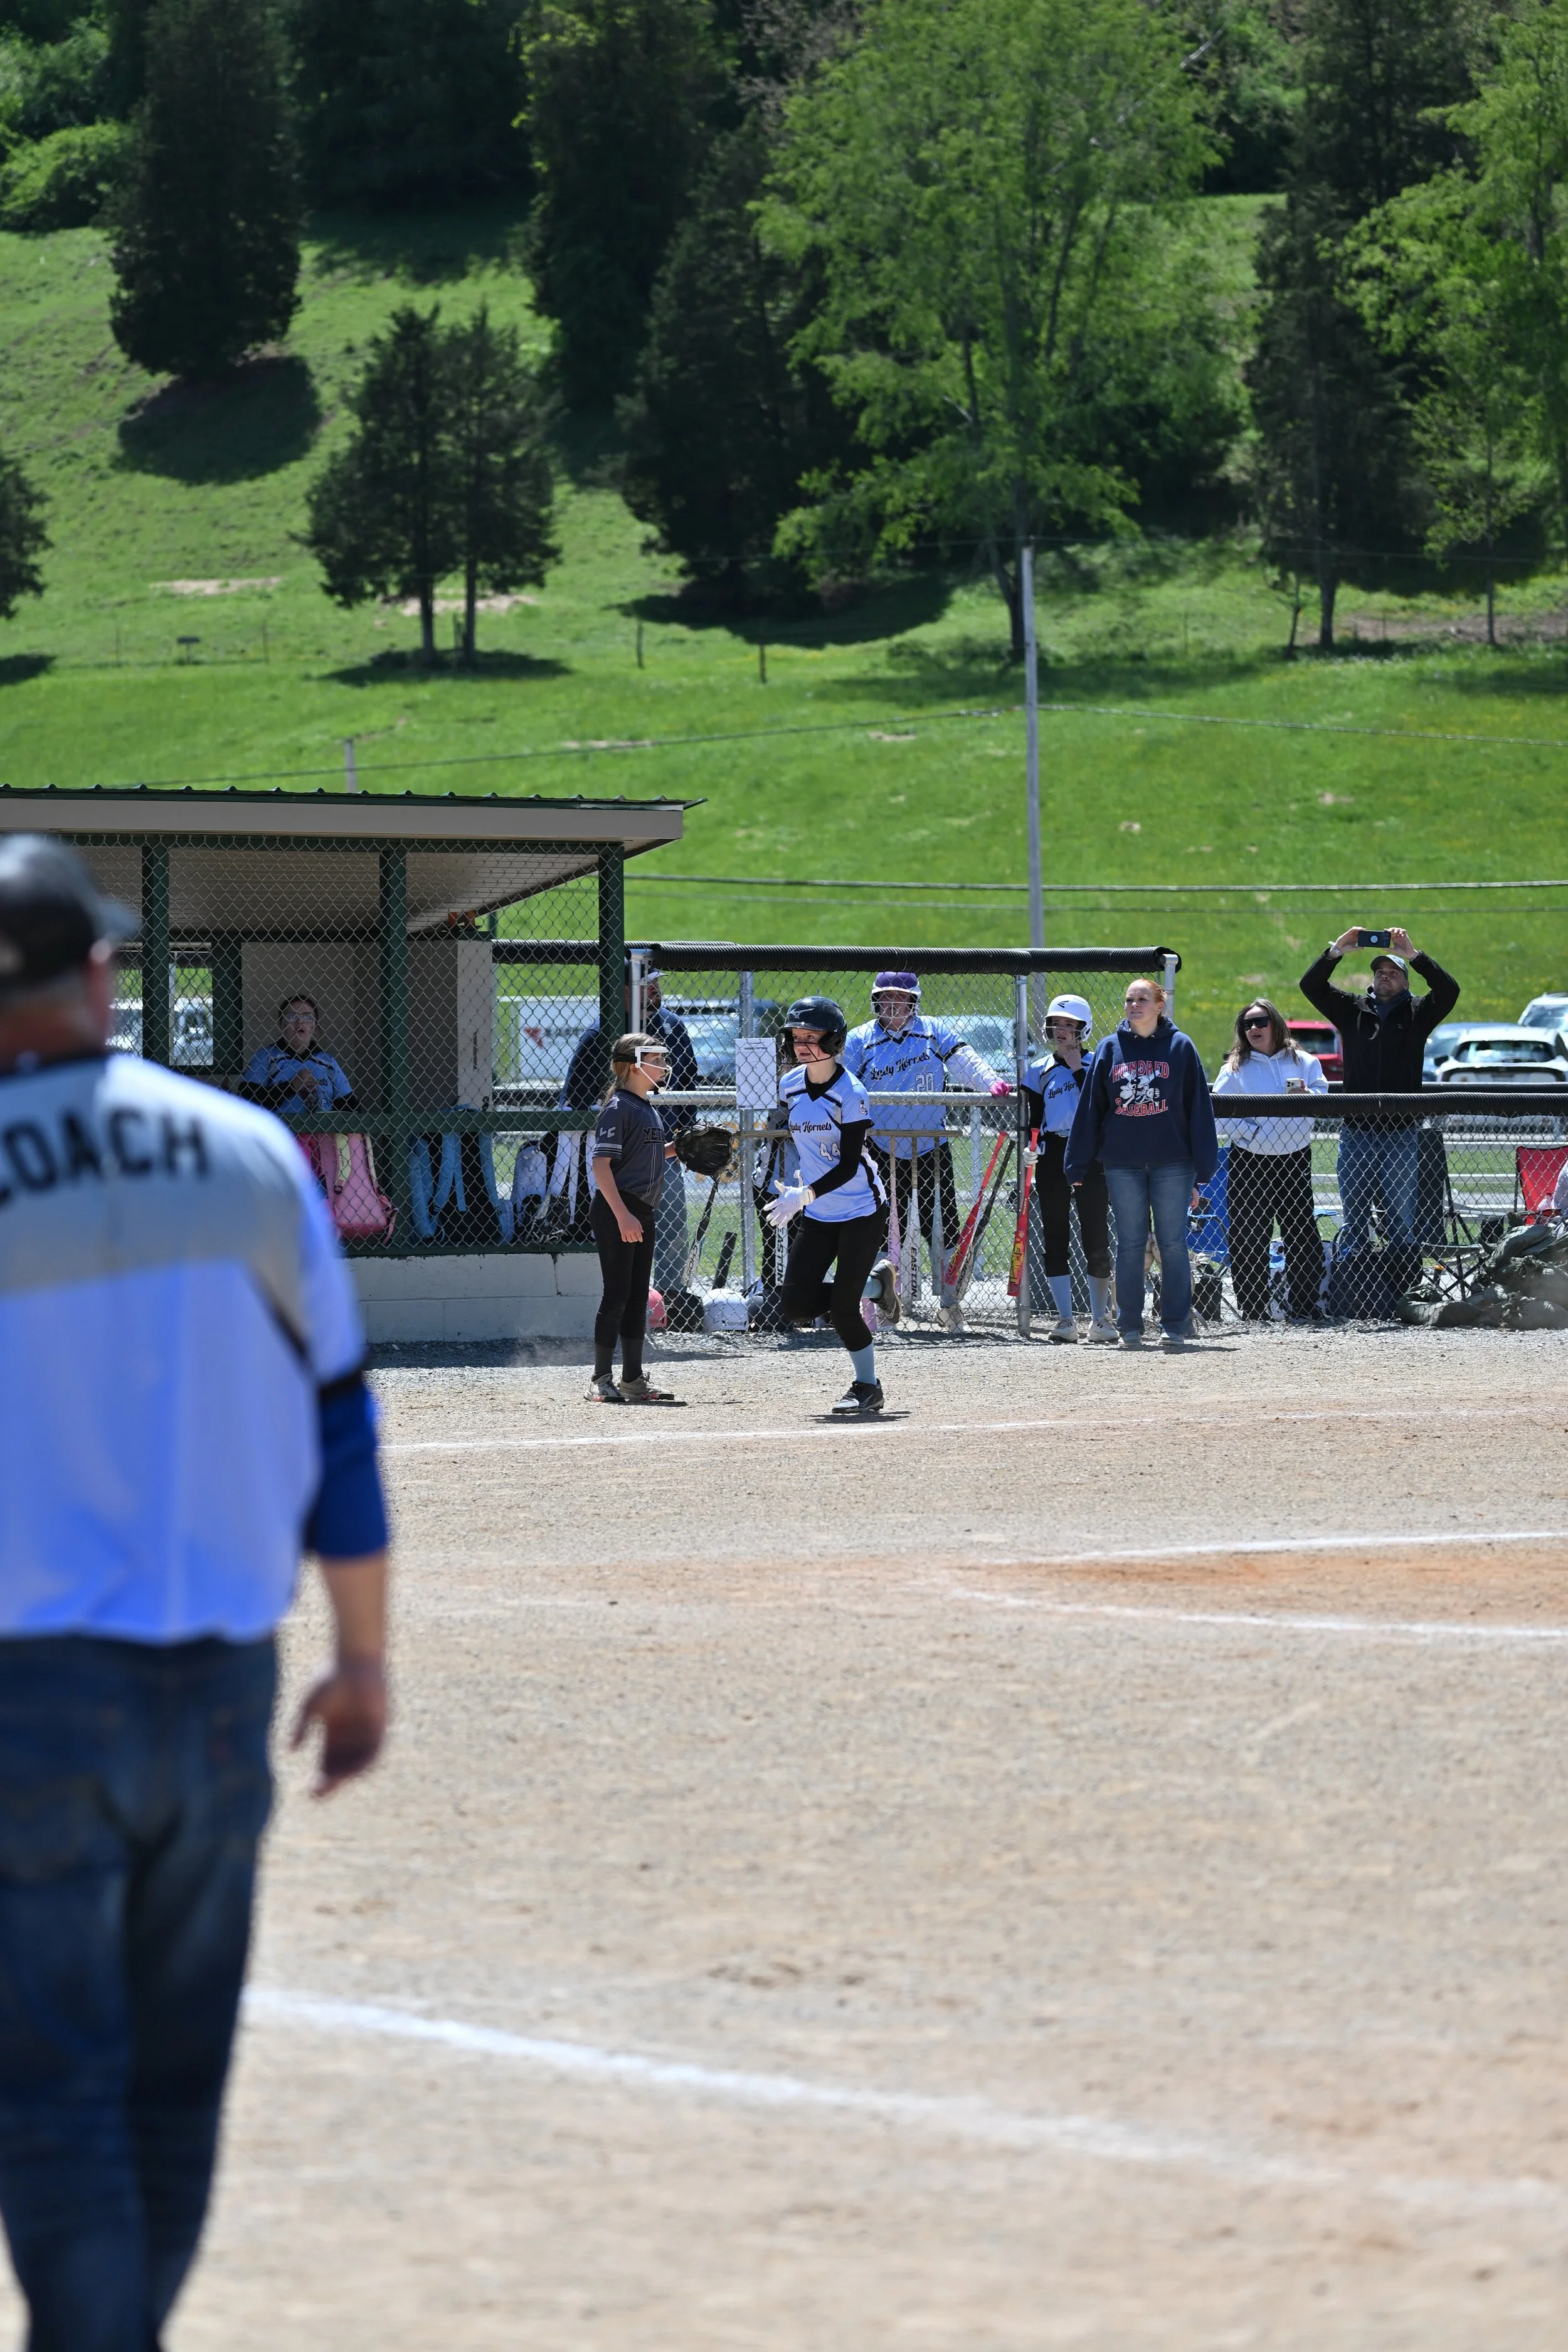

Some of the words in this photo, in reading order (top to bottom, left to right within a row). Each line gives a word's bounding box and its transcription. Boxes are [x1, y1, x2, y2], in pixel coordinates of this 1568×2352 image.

[871, 1066, 894, 1081] Lady
[896, 1052, 930, 1073] Hornets
[1112, 1060, 1170, 1084] HUNDRED
[915, 1072, 935, 1092] 20
[1048, 1086, 1063, 1099] Lady
[1115, 1098, 1169, 1117] BASEBALL
[803, 1121, 832, 1133] Hornets
[0, 1105, 212, 1209] OACH
